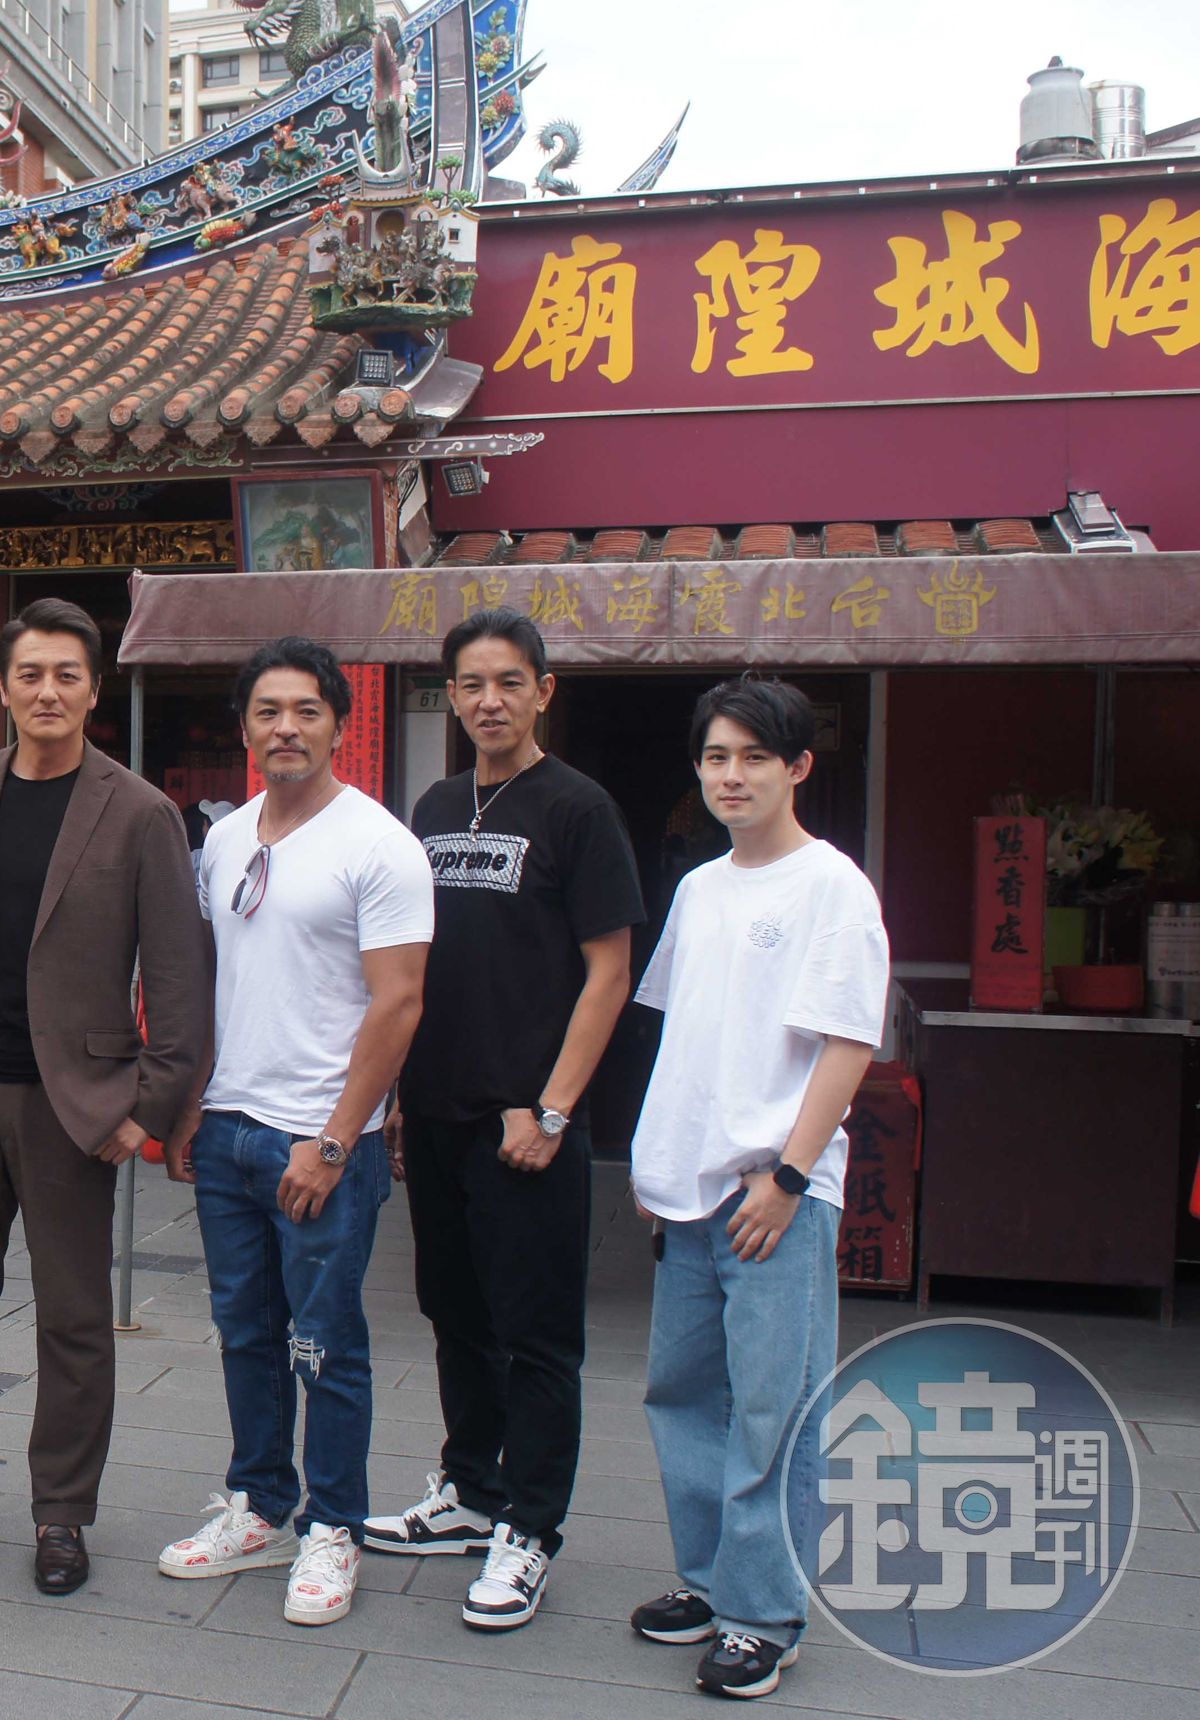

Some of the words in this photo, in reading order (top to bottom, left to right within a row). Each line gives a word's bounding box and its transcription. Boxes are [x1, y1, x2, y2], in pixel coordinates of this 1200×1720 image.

[420, 691, 440, 707] 61
[990, 822, 1031, 955] 點香處
